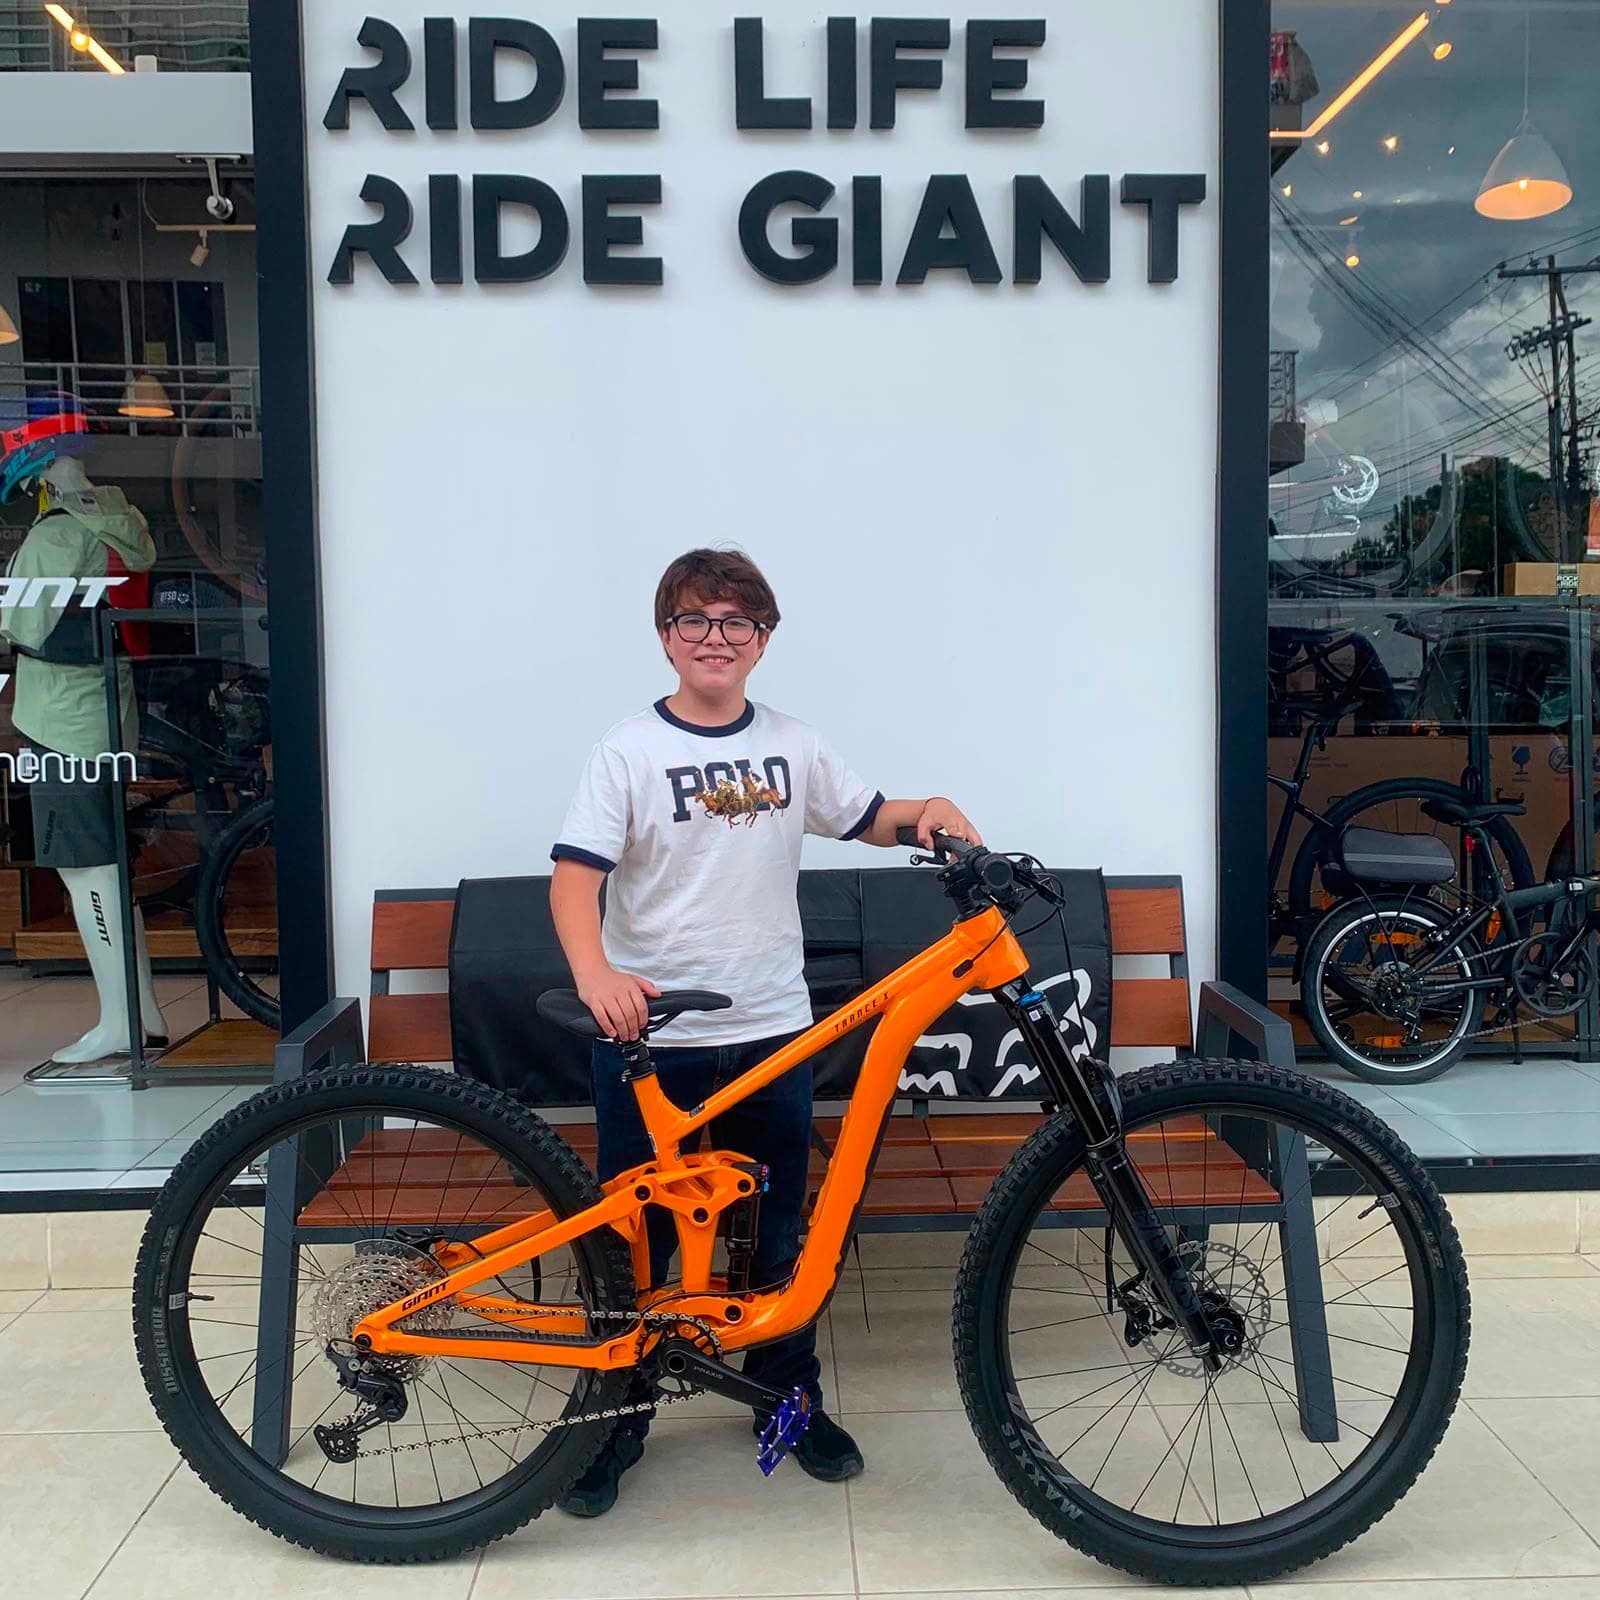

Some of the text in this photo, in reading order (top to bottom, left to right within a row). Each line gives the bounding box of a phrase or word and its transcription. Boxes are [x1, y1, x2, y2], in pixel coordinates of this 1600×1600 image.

[323, 16, 1046, 130] RIDE LIFE
[327, 169, 1207, 286] RIDE GIANT
[90, 890, 112, 947] GIANT
[834, 991, 889, 1033] TRANCE X
[1333, 1122, 1388, 1166] MINION
[402, 1279, 450, 1312] GIANT
[1001, 1421, 1084, 1521] MAXXIS
